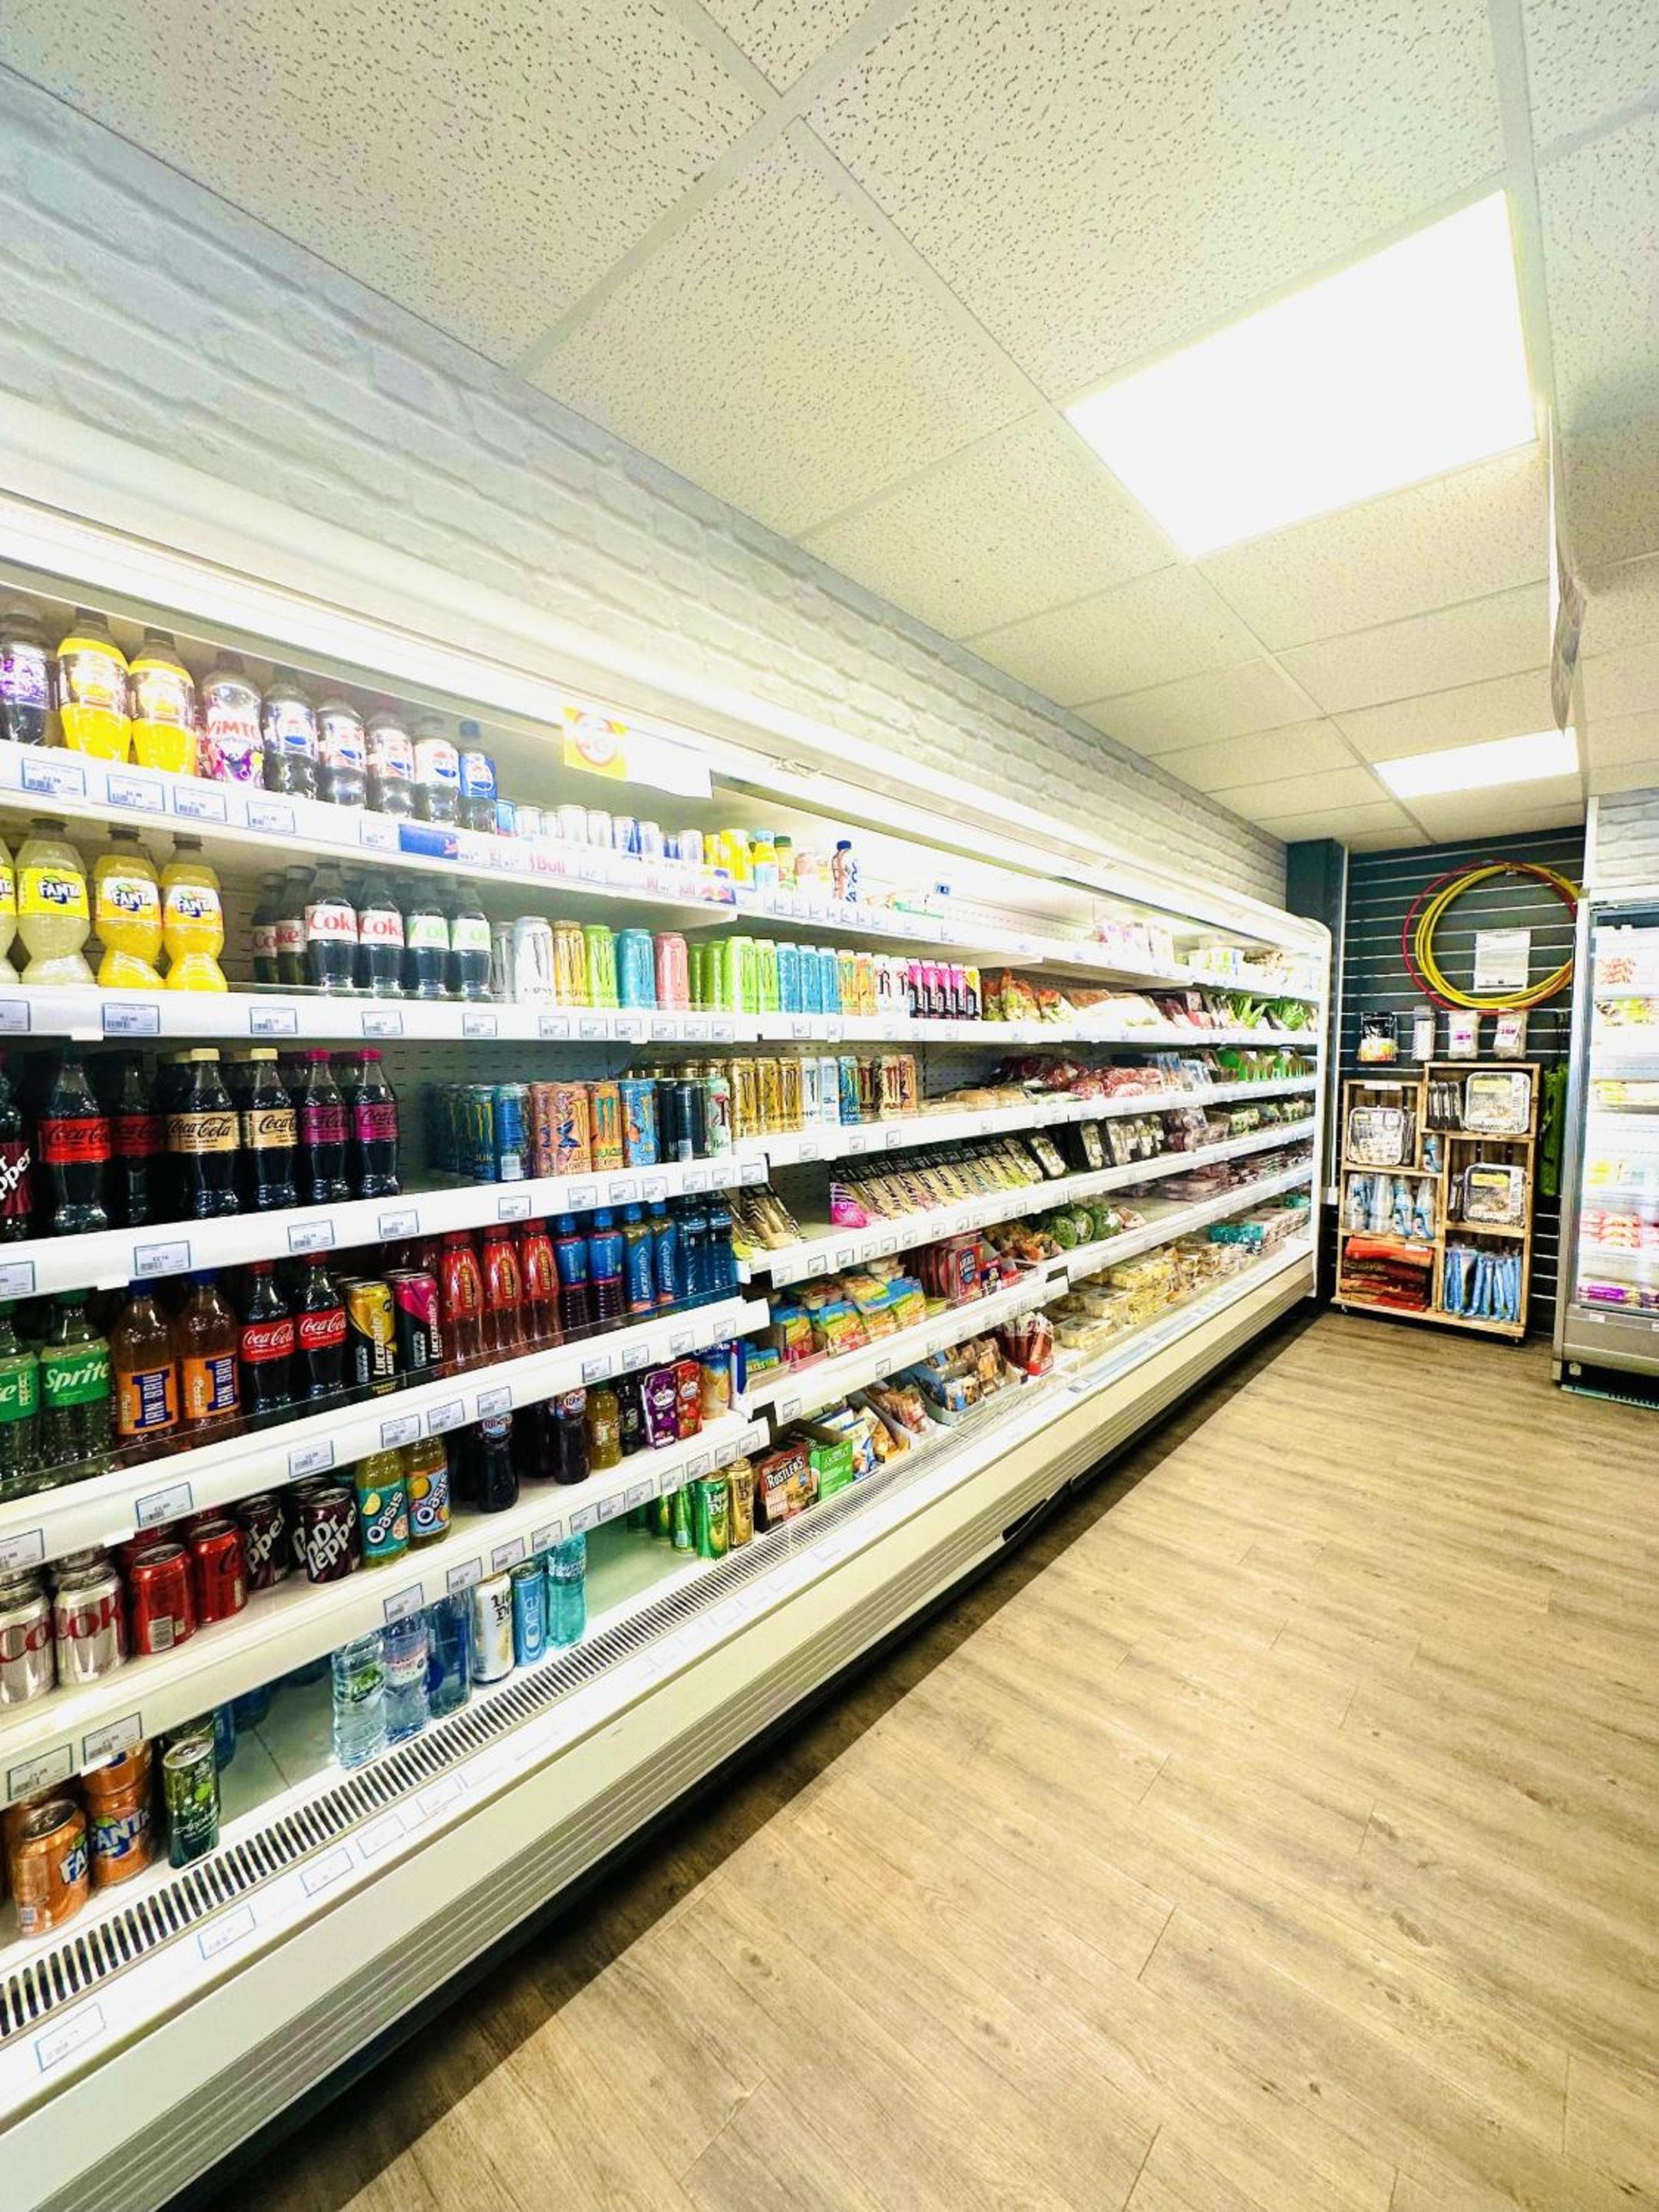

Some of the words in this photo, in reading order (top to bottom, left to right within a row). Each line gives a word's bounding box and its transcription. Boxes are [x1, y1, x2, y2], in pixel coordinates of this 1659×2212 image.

[167, 1117, 233, 1139] Coca-Cola
[259, 1114, 296, 1134] Coca-C
[373, 1312, 386, 1375] Lucozade
[45, 1362, 110, 1394] Sprite
[767, 1456, 805, 1490] RUSTLERS
[417, 1473, 448, 1524] Oasis
[311, 1515, 338, 1545] Dr
[367, 1491, 403, 1543] Oasis
[0, 1622, 51, 1663] Co
